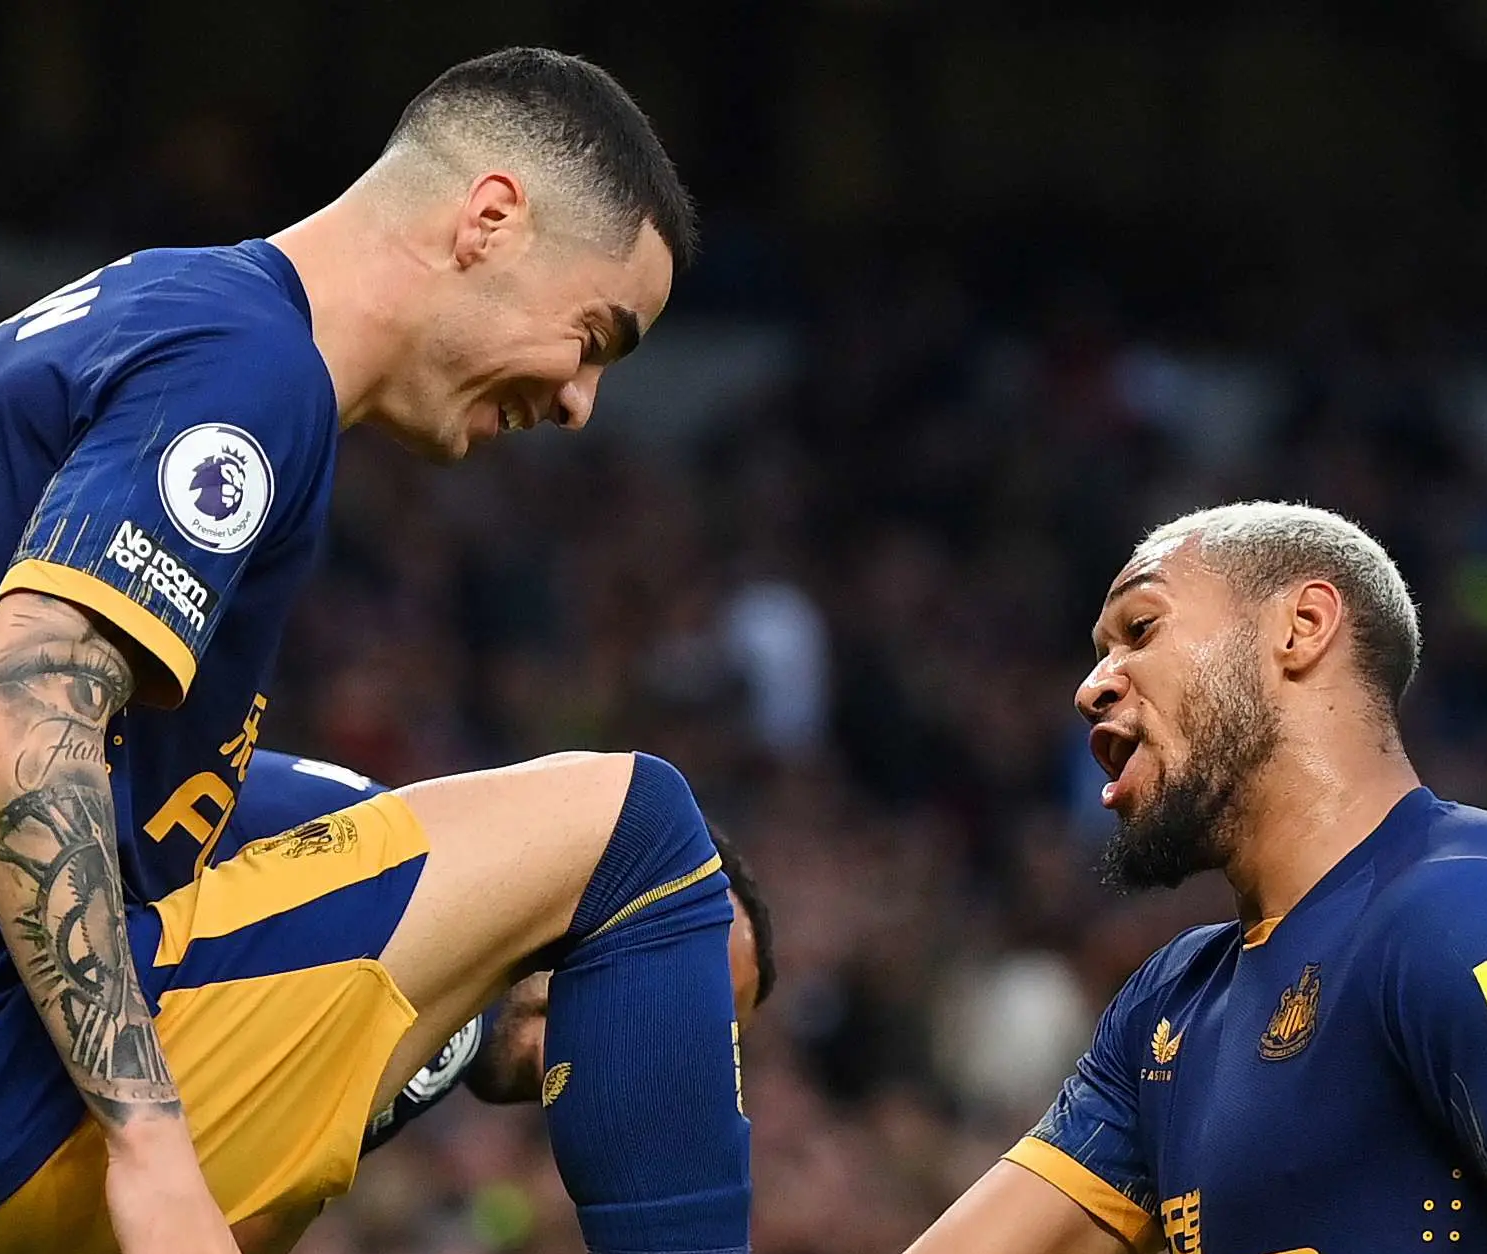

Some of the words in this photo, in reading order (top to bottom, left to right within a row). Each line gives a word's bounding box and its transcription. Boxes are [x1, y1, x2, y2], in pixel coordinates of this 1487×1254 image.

[114, 519, 153, 559] No
[152, 550, 209, 608] room
[191, 518, 227, 539] Premier
[228, 509, 253, 538] League
[105, 538, 146, 574] for
[141, 564, 206, 633] racism
